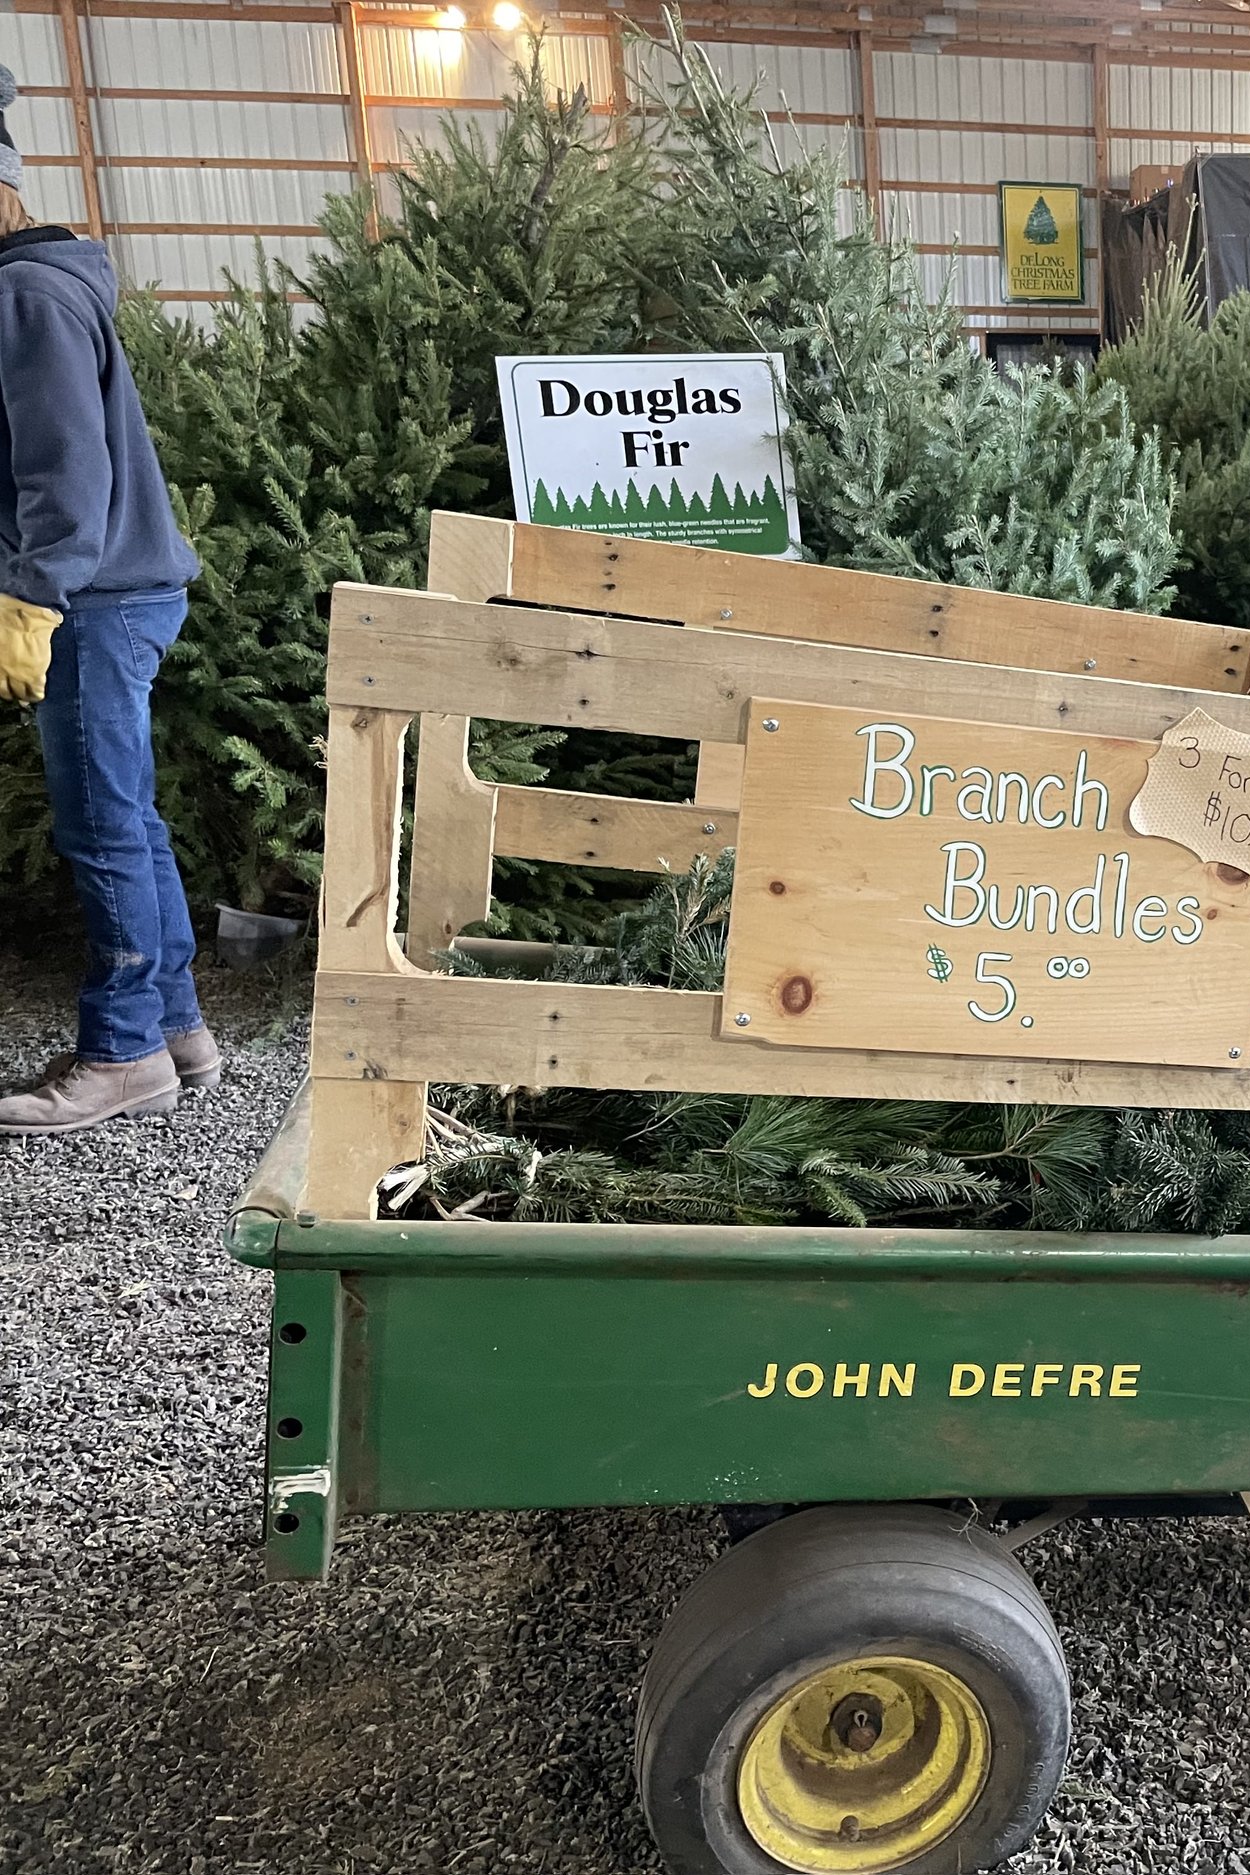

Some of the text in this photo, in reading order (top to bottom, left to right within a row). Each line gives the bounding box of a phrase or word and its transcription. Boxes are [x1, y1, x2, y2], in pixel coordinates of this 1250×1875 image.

[1011, 267, 1074, 279] CHRISTMAS
[1011, 279, 1073, 291] TREE FARM
[537, 377, 742, 424] Douglas
[620, 429, 690, 468] Fir
[668, 520, 699, 529] blue-green
[668, 529, 686, 537] sturdy
[728, 527, 762, 536] symmetrical
[1178, 736, 1201, 769] 3
[848, 722, 1110, 831] Branch
[924, 840, 1203, 945] Bundles
[746, 1362, 917, 1399] JOHN
